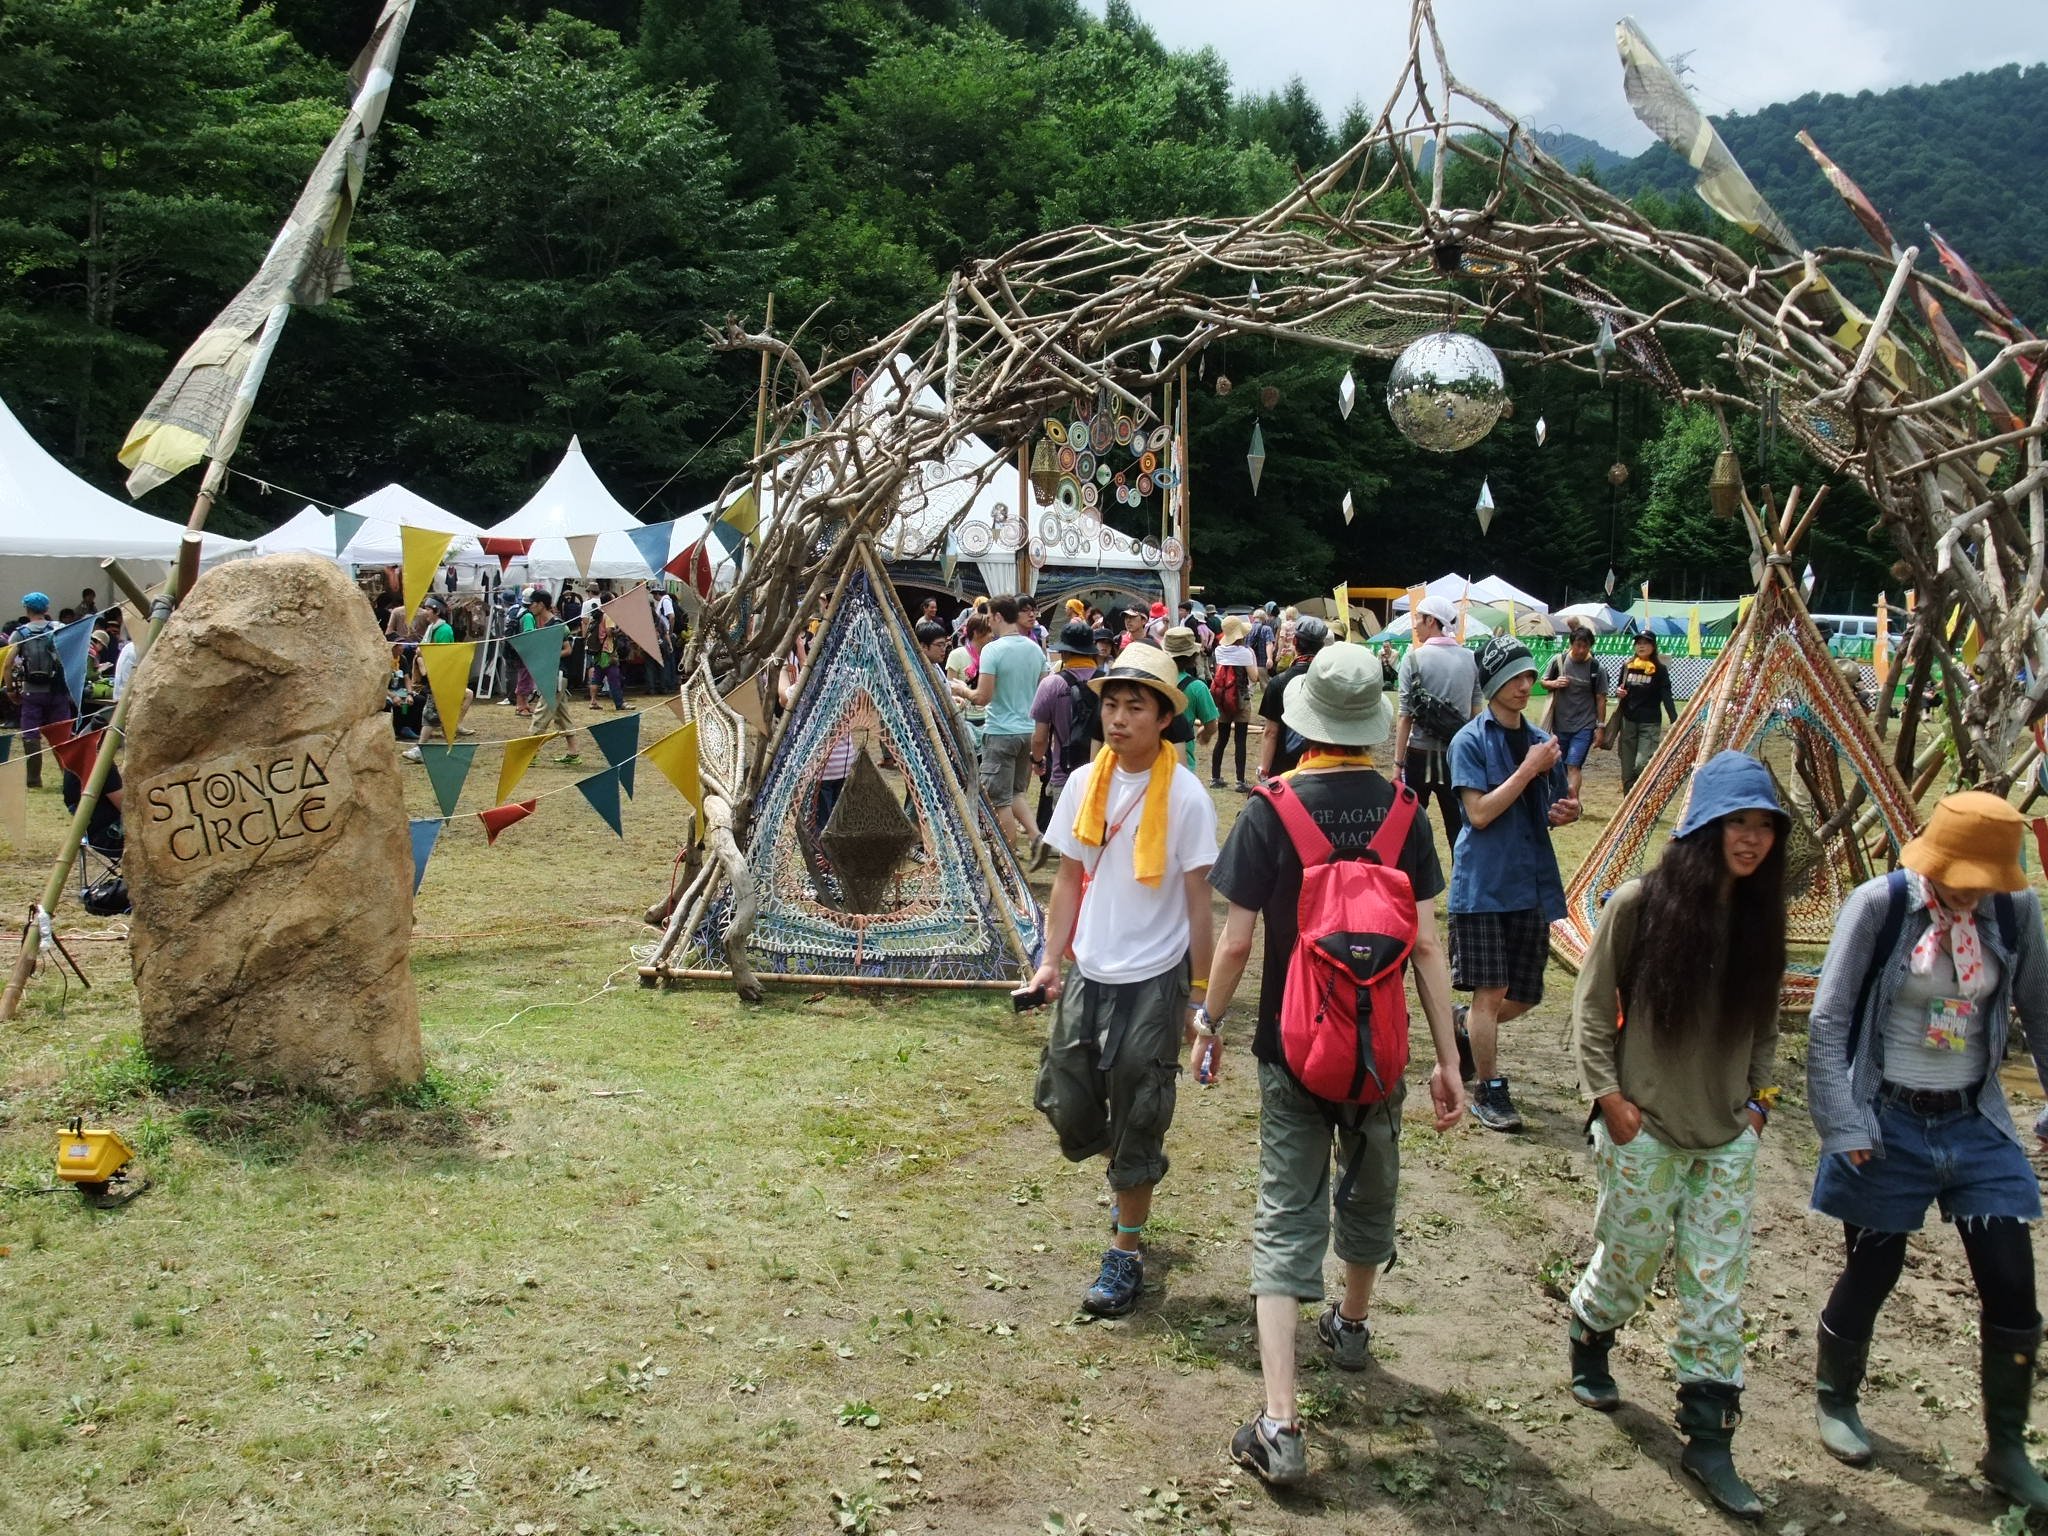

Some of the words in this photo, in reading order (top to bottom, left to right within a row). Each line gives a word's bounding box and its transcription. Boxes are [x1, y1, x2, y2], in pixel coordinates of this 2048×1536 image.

[1311, 809, 1335, 825] GE
[170, 797, 332, 861] CIRCLE
[1330, 830, 1375, 847] MAC
